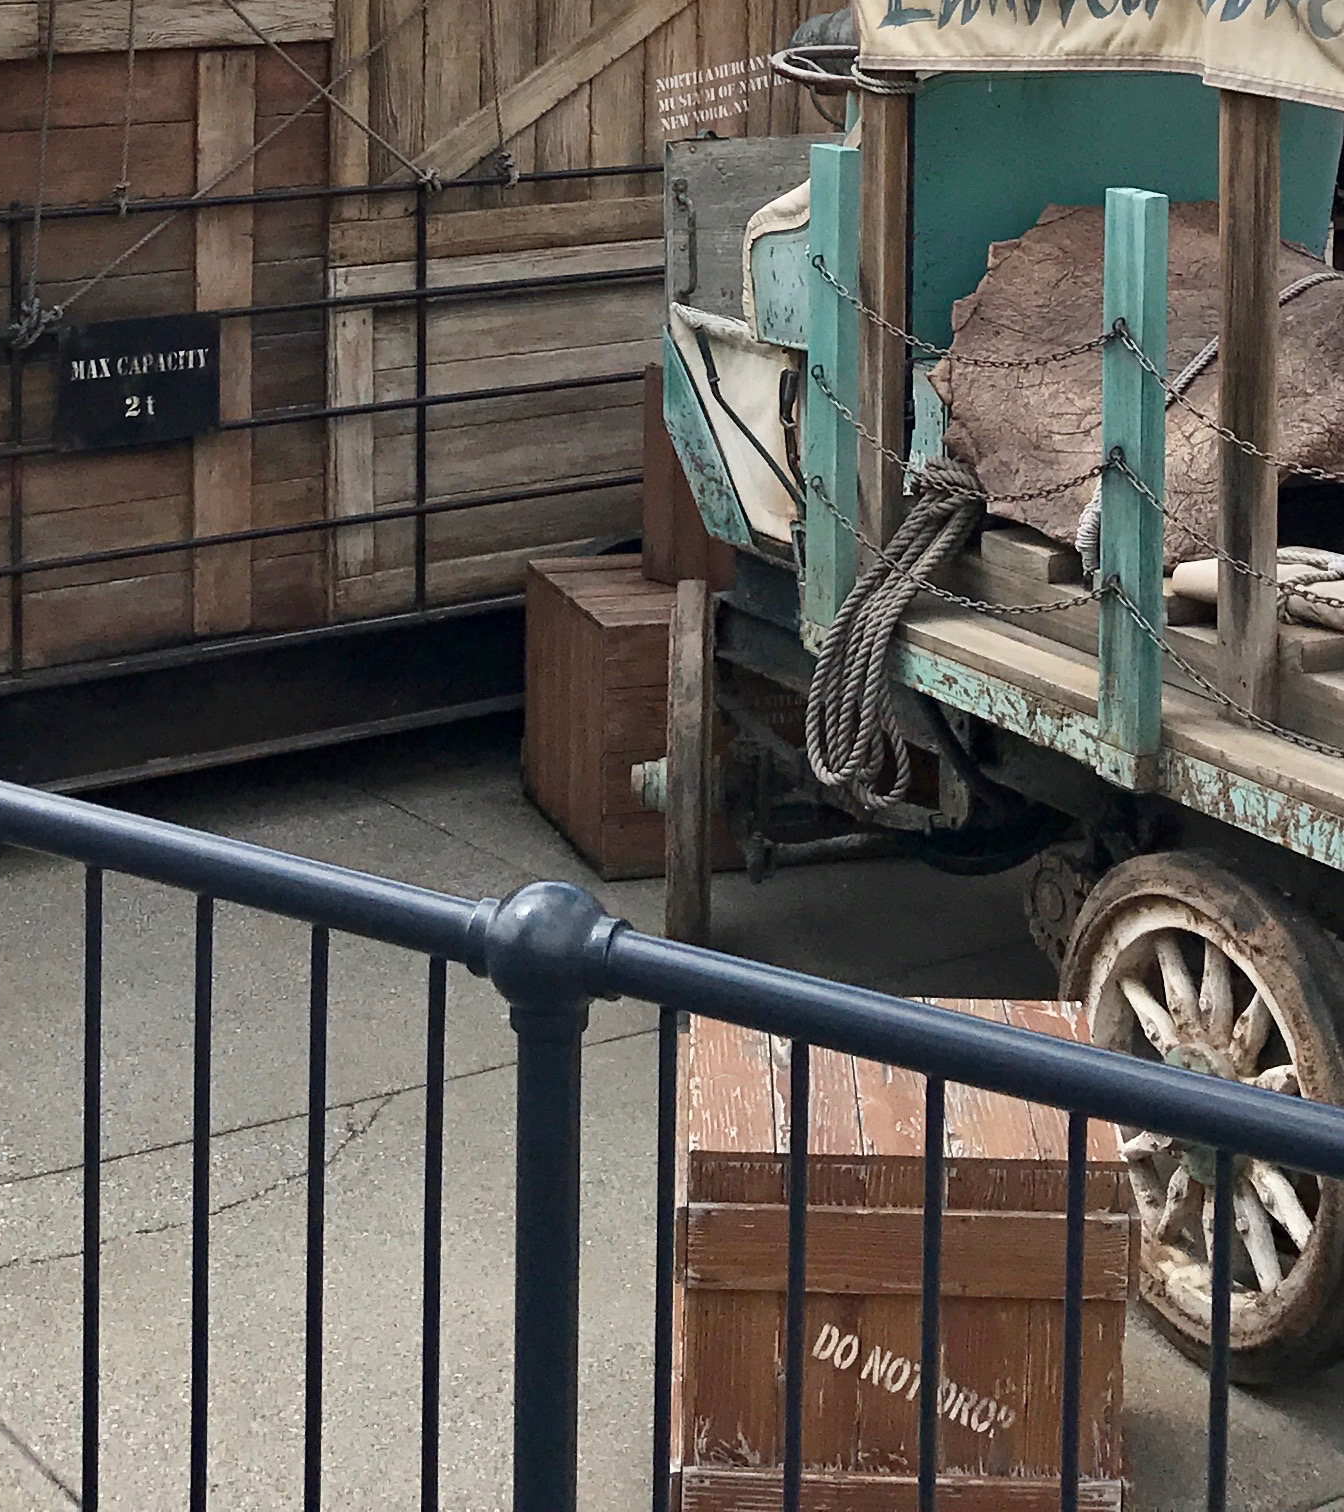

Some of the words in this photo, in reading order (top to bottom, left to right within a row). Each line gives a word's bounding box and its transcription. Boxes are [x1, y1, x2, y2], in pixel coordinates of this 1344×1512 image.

[656, 69, 703, 93] NORTH
[718, 82, 736, 99] OF
[661, 112, 691, 132] NEW
[70, 357, 111, 382] MAX
[116, 348, 209, 376] CAPACITY
[811, 1322, 859, 1370] DO
[860, 1345, 922, 1401] NOT
